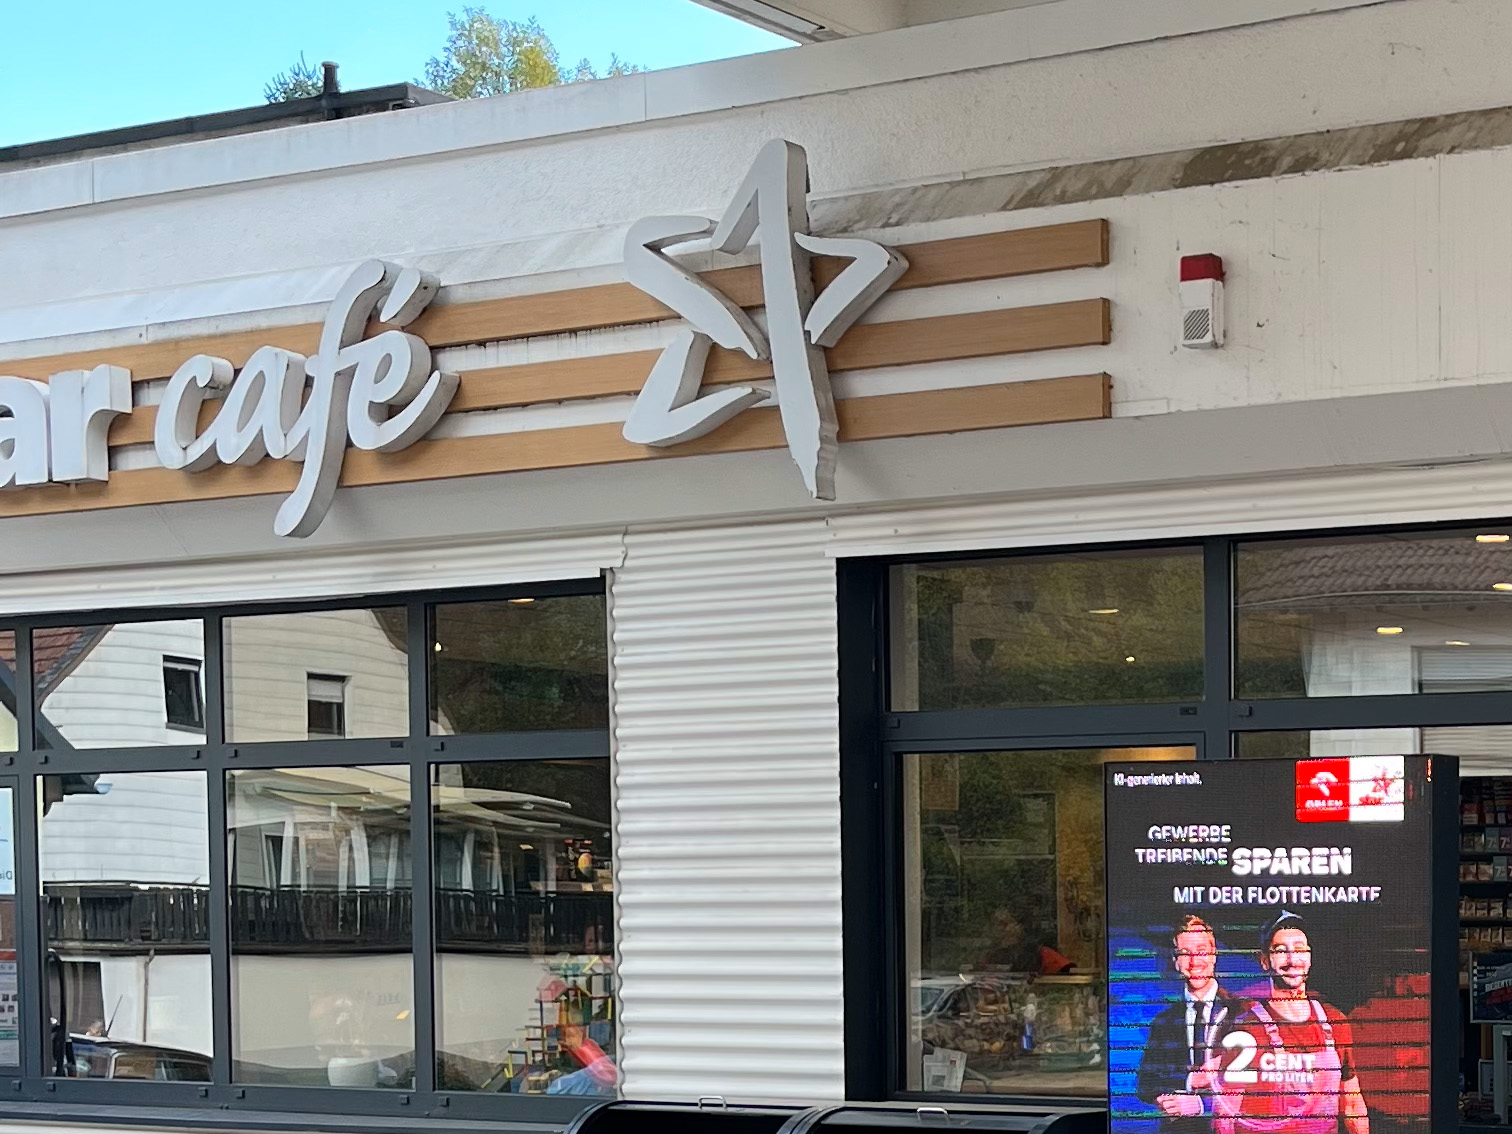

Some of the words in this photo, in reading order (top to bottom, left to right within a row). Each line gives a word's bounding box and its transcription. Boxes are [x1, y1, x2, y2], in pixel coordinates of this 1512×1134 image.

[155, 258, 459, 538] café
[1232, 847, 1352, 875] SPAREN
[1173, 886, 1205, 904] MIT
[1209, 886, 1243, 904] DER
[1222, 1030, 1258, 1083] 2
[1260, 1052, 1316, 1071] CENT
[1261, 1071, 1283, 1083] PRO
[1285, 1071, 1315, 1084] LITER
